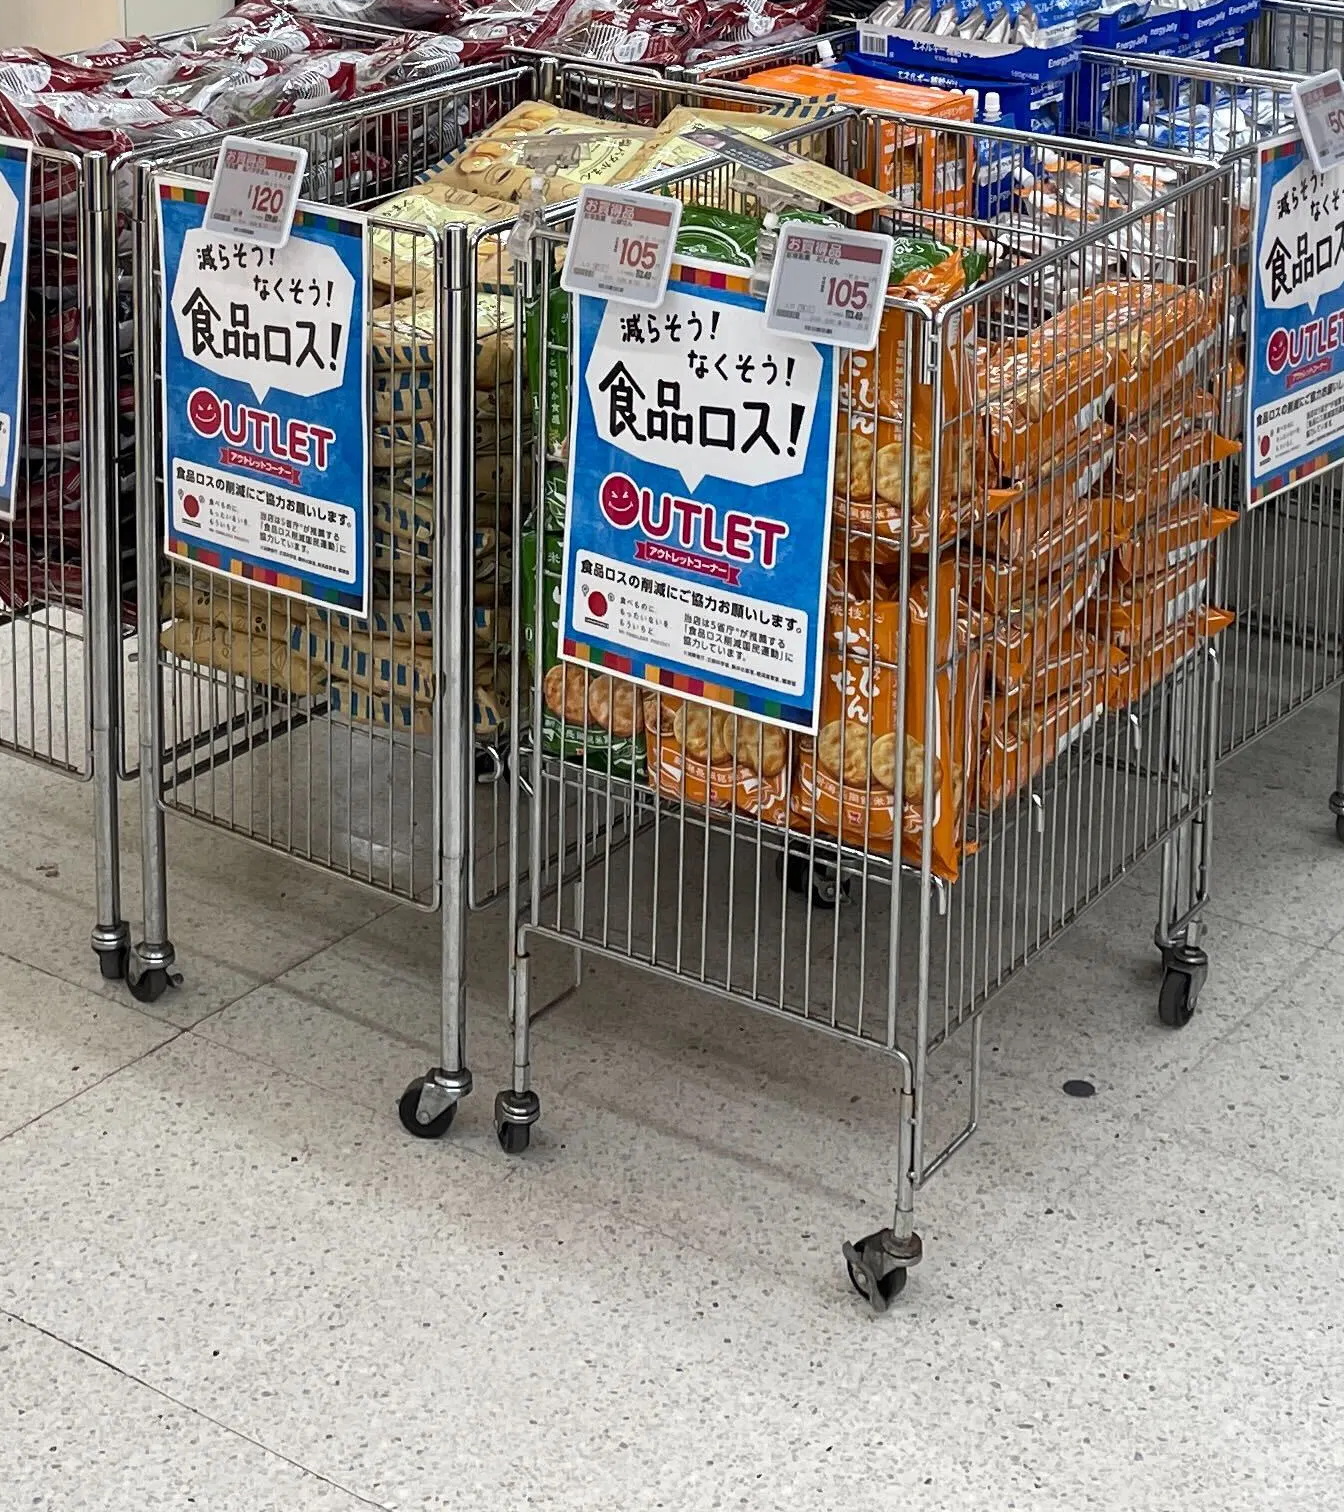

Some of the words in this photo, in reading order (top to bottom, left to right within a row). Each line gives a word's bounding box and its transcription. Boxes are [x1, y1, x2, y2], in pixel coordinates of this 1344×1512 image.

[251, 184, 285, 214] 120
[585, 199, 635, 221] お買得品
[197, 243, 276, 273] 減らそう!
[619, 237, 659, 270] 105
[788, 238, 842, 259] お買得品
[253, 273, 335, 309] なくそう!
[826, 277, 870, 310] 105
[181, 287, 343, 372] 食品ロス!
[620, 310, 721, 345] 減らそう!
[686, 349, 796, 387] なくそう!
[598, 359, 806, 458] 食品ロス!
[187, 386, 336, 473] OUTLET
[175, 465, 353, 529] 食品ロスの削減にご協力お願いします。
[601, 473, 788, 567] OUTLET
[648, 544, 728, 575] アウトレットコーナー
[580, 558, 803, 635] 食品ロスの削減にご協力お願いします。
[683, 635, 748, 663] 協力しています。
